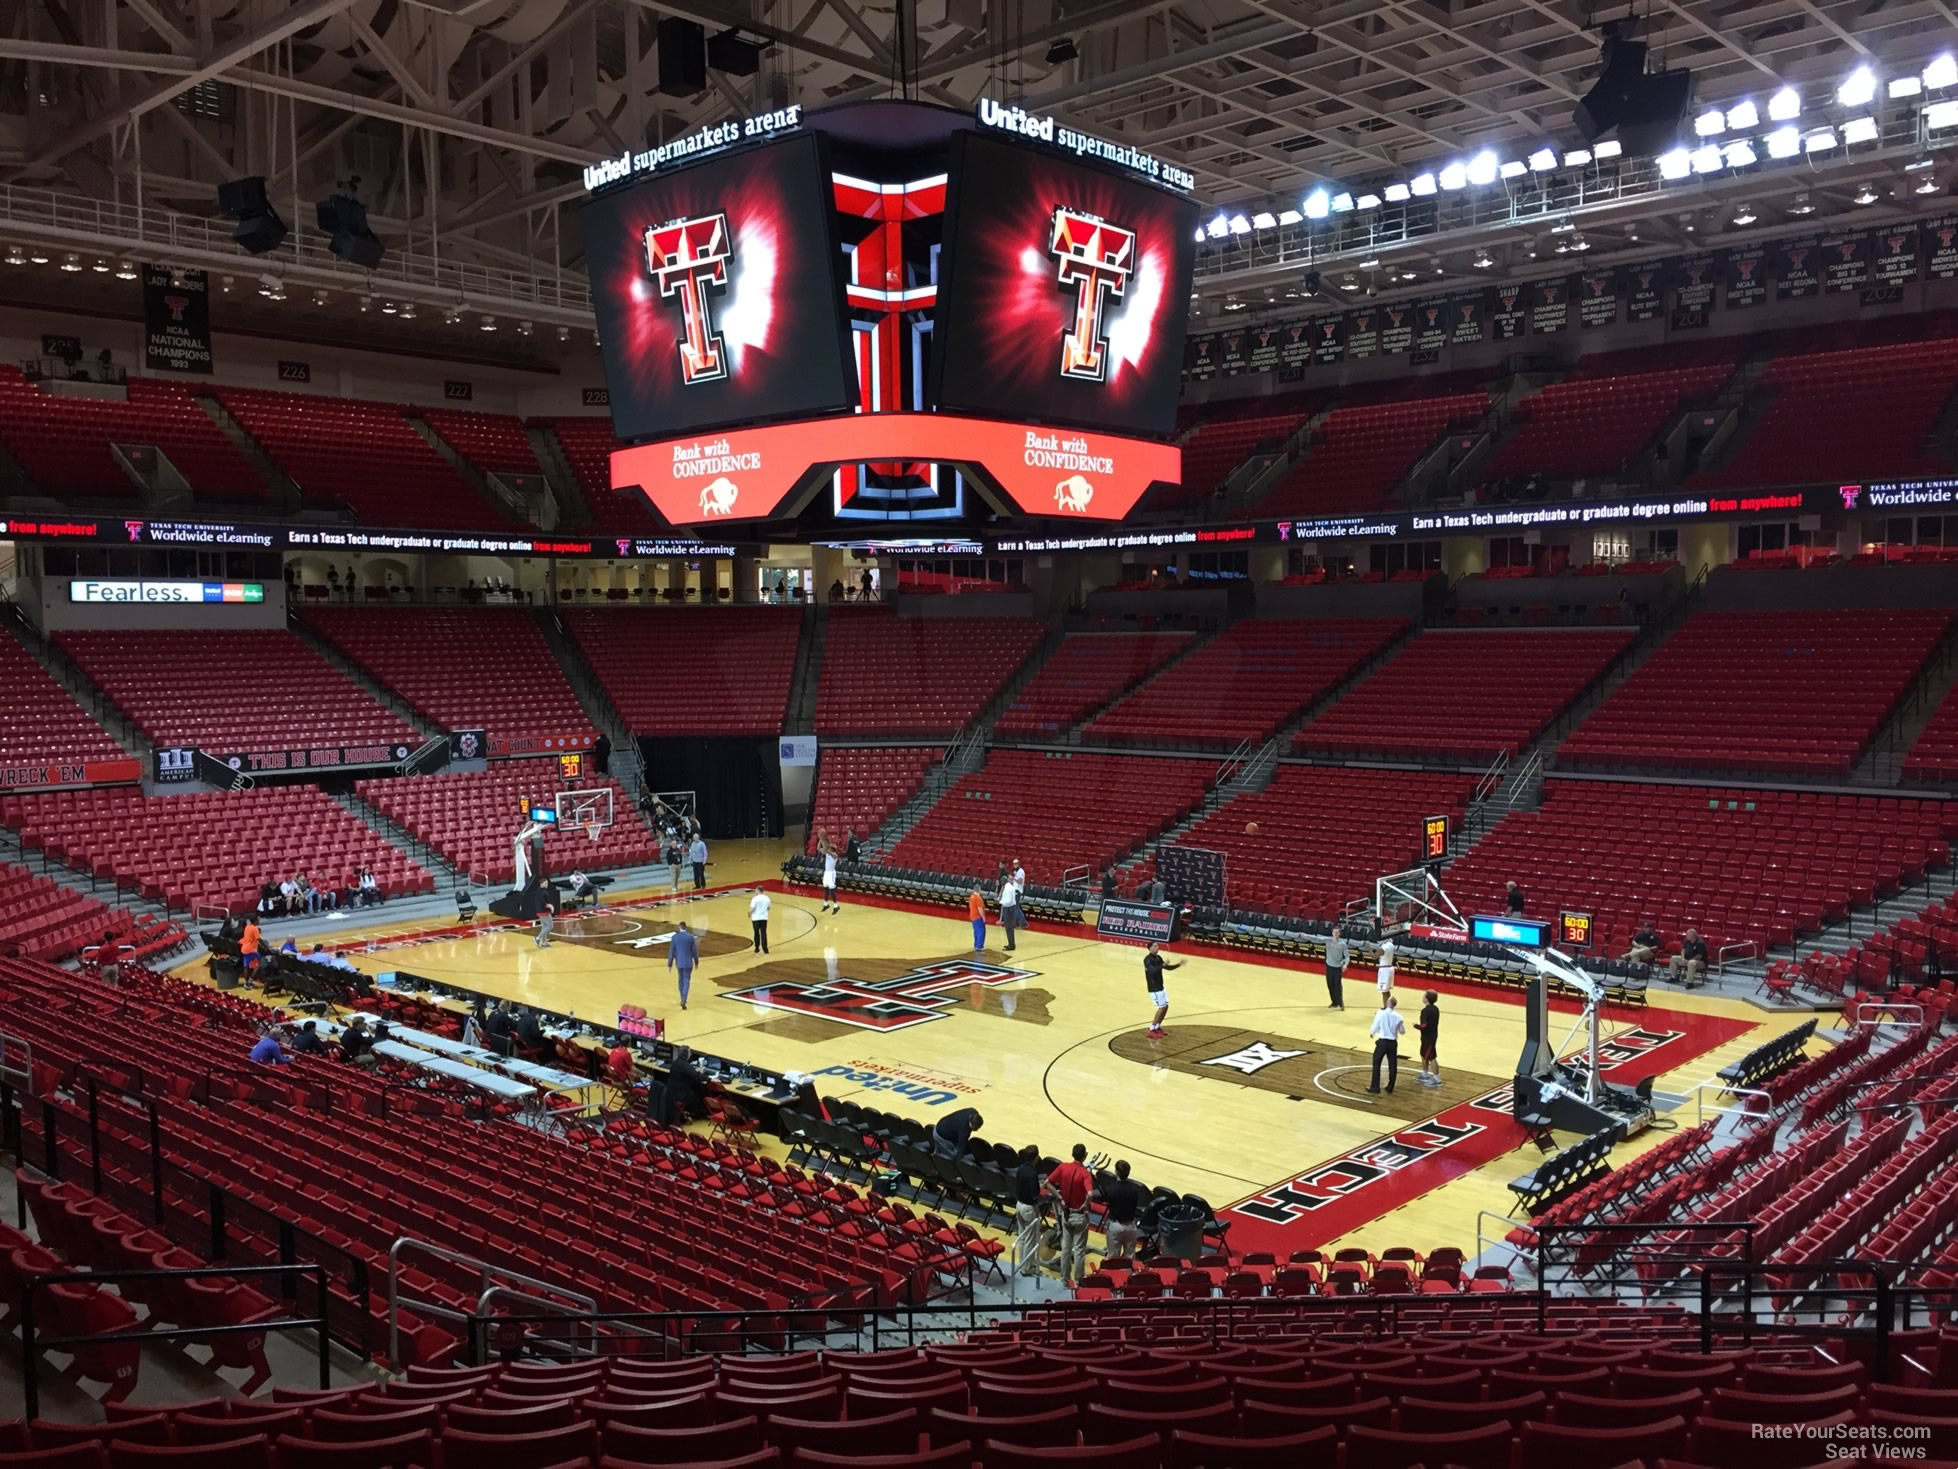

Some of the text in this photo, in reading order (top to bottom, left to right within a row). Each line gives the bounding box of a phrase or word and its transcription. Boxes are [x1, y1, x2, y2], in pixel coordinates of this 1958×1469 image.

[584, 106, 799, 190] United supermarkets arena
[980, 98, 1194, 190] United supermarkets arena
[1878, 254, 1915, 265] CHAMPIONS
[147, 275, 168, 287] LADY
[1876, 268, 1918, 280] TOURNAMENT
[1499, 287, 1519, 298] SHARP
[166, 326, 189, 336] NCAA
[152, 334, 205, 349] NATIONAL
[148, 346, 209, 361] CHAMPIONS
[283, 364, 306, 380] 226
[448, 384, 469, 397] 227
[586, 391, 608, 403] 228
[1024, 431, 1088, 454] Bank with
[673, 439, 730, 462] Bank with
[673, 452, 761, 479] CONFIDENCE
[1024, 449, 1113, 474] CONFIDENCE
[1900, 482, 1924, 490] TECH
[1869, 489, 1951, 505] Worldwide
[1413, 493, 1802, 529] Earn a Texas Tech undergraduate or graduate degree online from anywhere!
[9, 520, 37, 534] from
[40, 521, 97, 537] anywhere!
[150, 522, 171, 530] TEXAS
[194, 524, 234, 532] UNIVERSITY
[1296, 523, 1398, 538] Worldwide eLearning
[151, 530, 273, 546] Worldwide eLearning
[289, 531, 592, 553] Earn a Texas Tech undergraduate or graduate degree online from anywhere!
[1025, 540, 1044, 550] Texas
[1046, 539, 1060, 549] Tech
[1061, 537, 1107, 550] undergraduate
[1109, 538, 1116, 546] or
[1118, 535, 1148, 548] graduate
[1149, 534, 1173, 545] degree
[1174, 532, 1197, 543] online
[1198, 530, 1215, 541] from
[1217, 528, 1255, 541] anywhere!
[636, 544, 736, 556] Worldwide eLearning
[86, 583, 189, 601] Fearless.
[249, 747, 391, 770] THIS IS OUR HOUSE
[562, 755, 580, 764] 60:00
[56, 764, 85, 782] 'EM
[160, 768, 194, 776] AMERICAN
[160, 773, 195, 781] CAMPUS
[565, 764, 579, 777] 30
[1428, 821, 1445, 834] 60:00
[1430, 834, 1443, 855] 30
[1105, 905, 1126, 915] PROTECT
[1134, 908, 1150, 917] HOUSE
[1109, 925, 1158, 936] BASKETBALL
[1565, 917, 1588, 929] 60:00
[1569, 928, 1584, 942] 30
[847, 1059, 982, 1095] supermarkets
[810, 1065, 958, 1106] United
[1230, 1118, 1488, 1224] TECH
